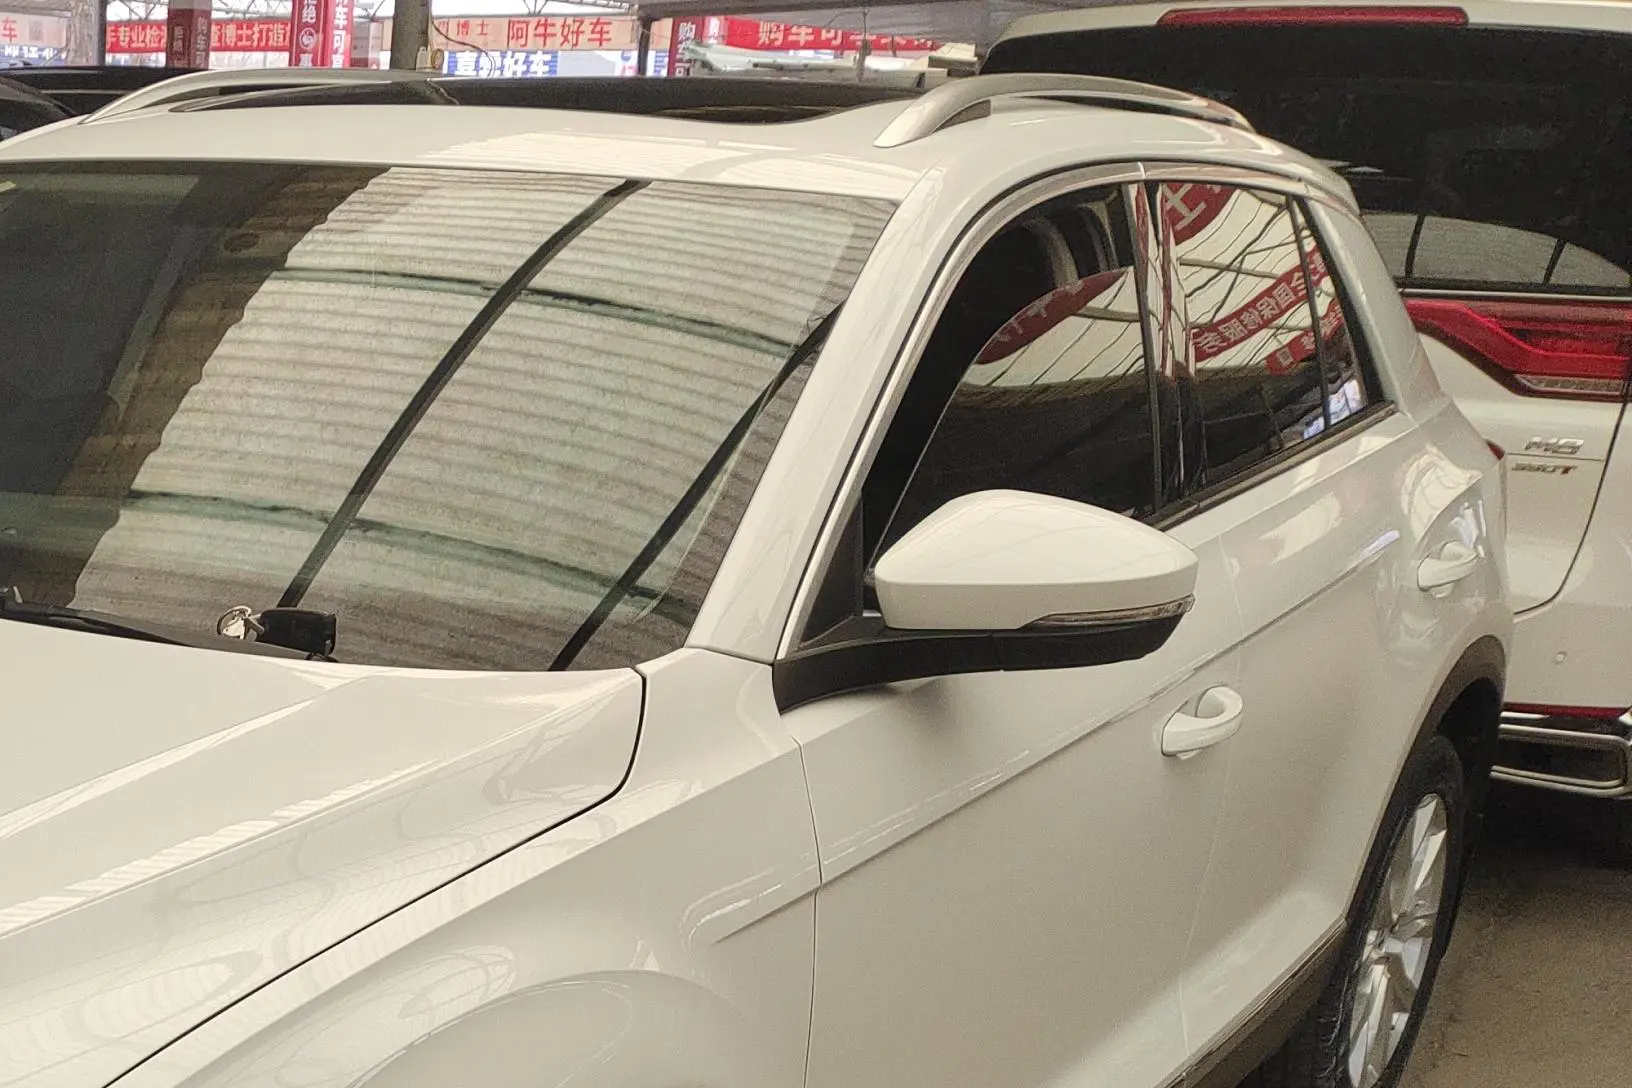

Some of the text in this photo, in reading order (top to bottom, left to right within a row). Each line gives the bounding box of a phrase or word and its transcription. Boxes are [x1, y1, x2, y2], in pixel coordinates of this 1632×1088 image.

[106, 25, 167, 49] 手专业检
[211, 22, 290, 48] 查博士打造
[507, 17, 613, 48] 阿牛好车
